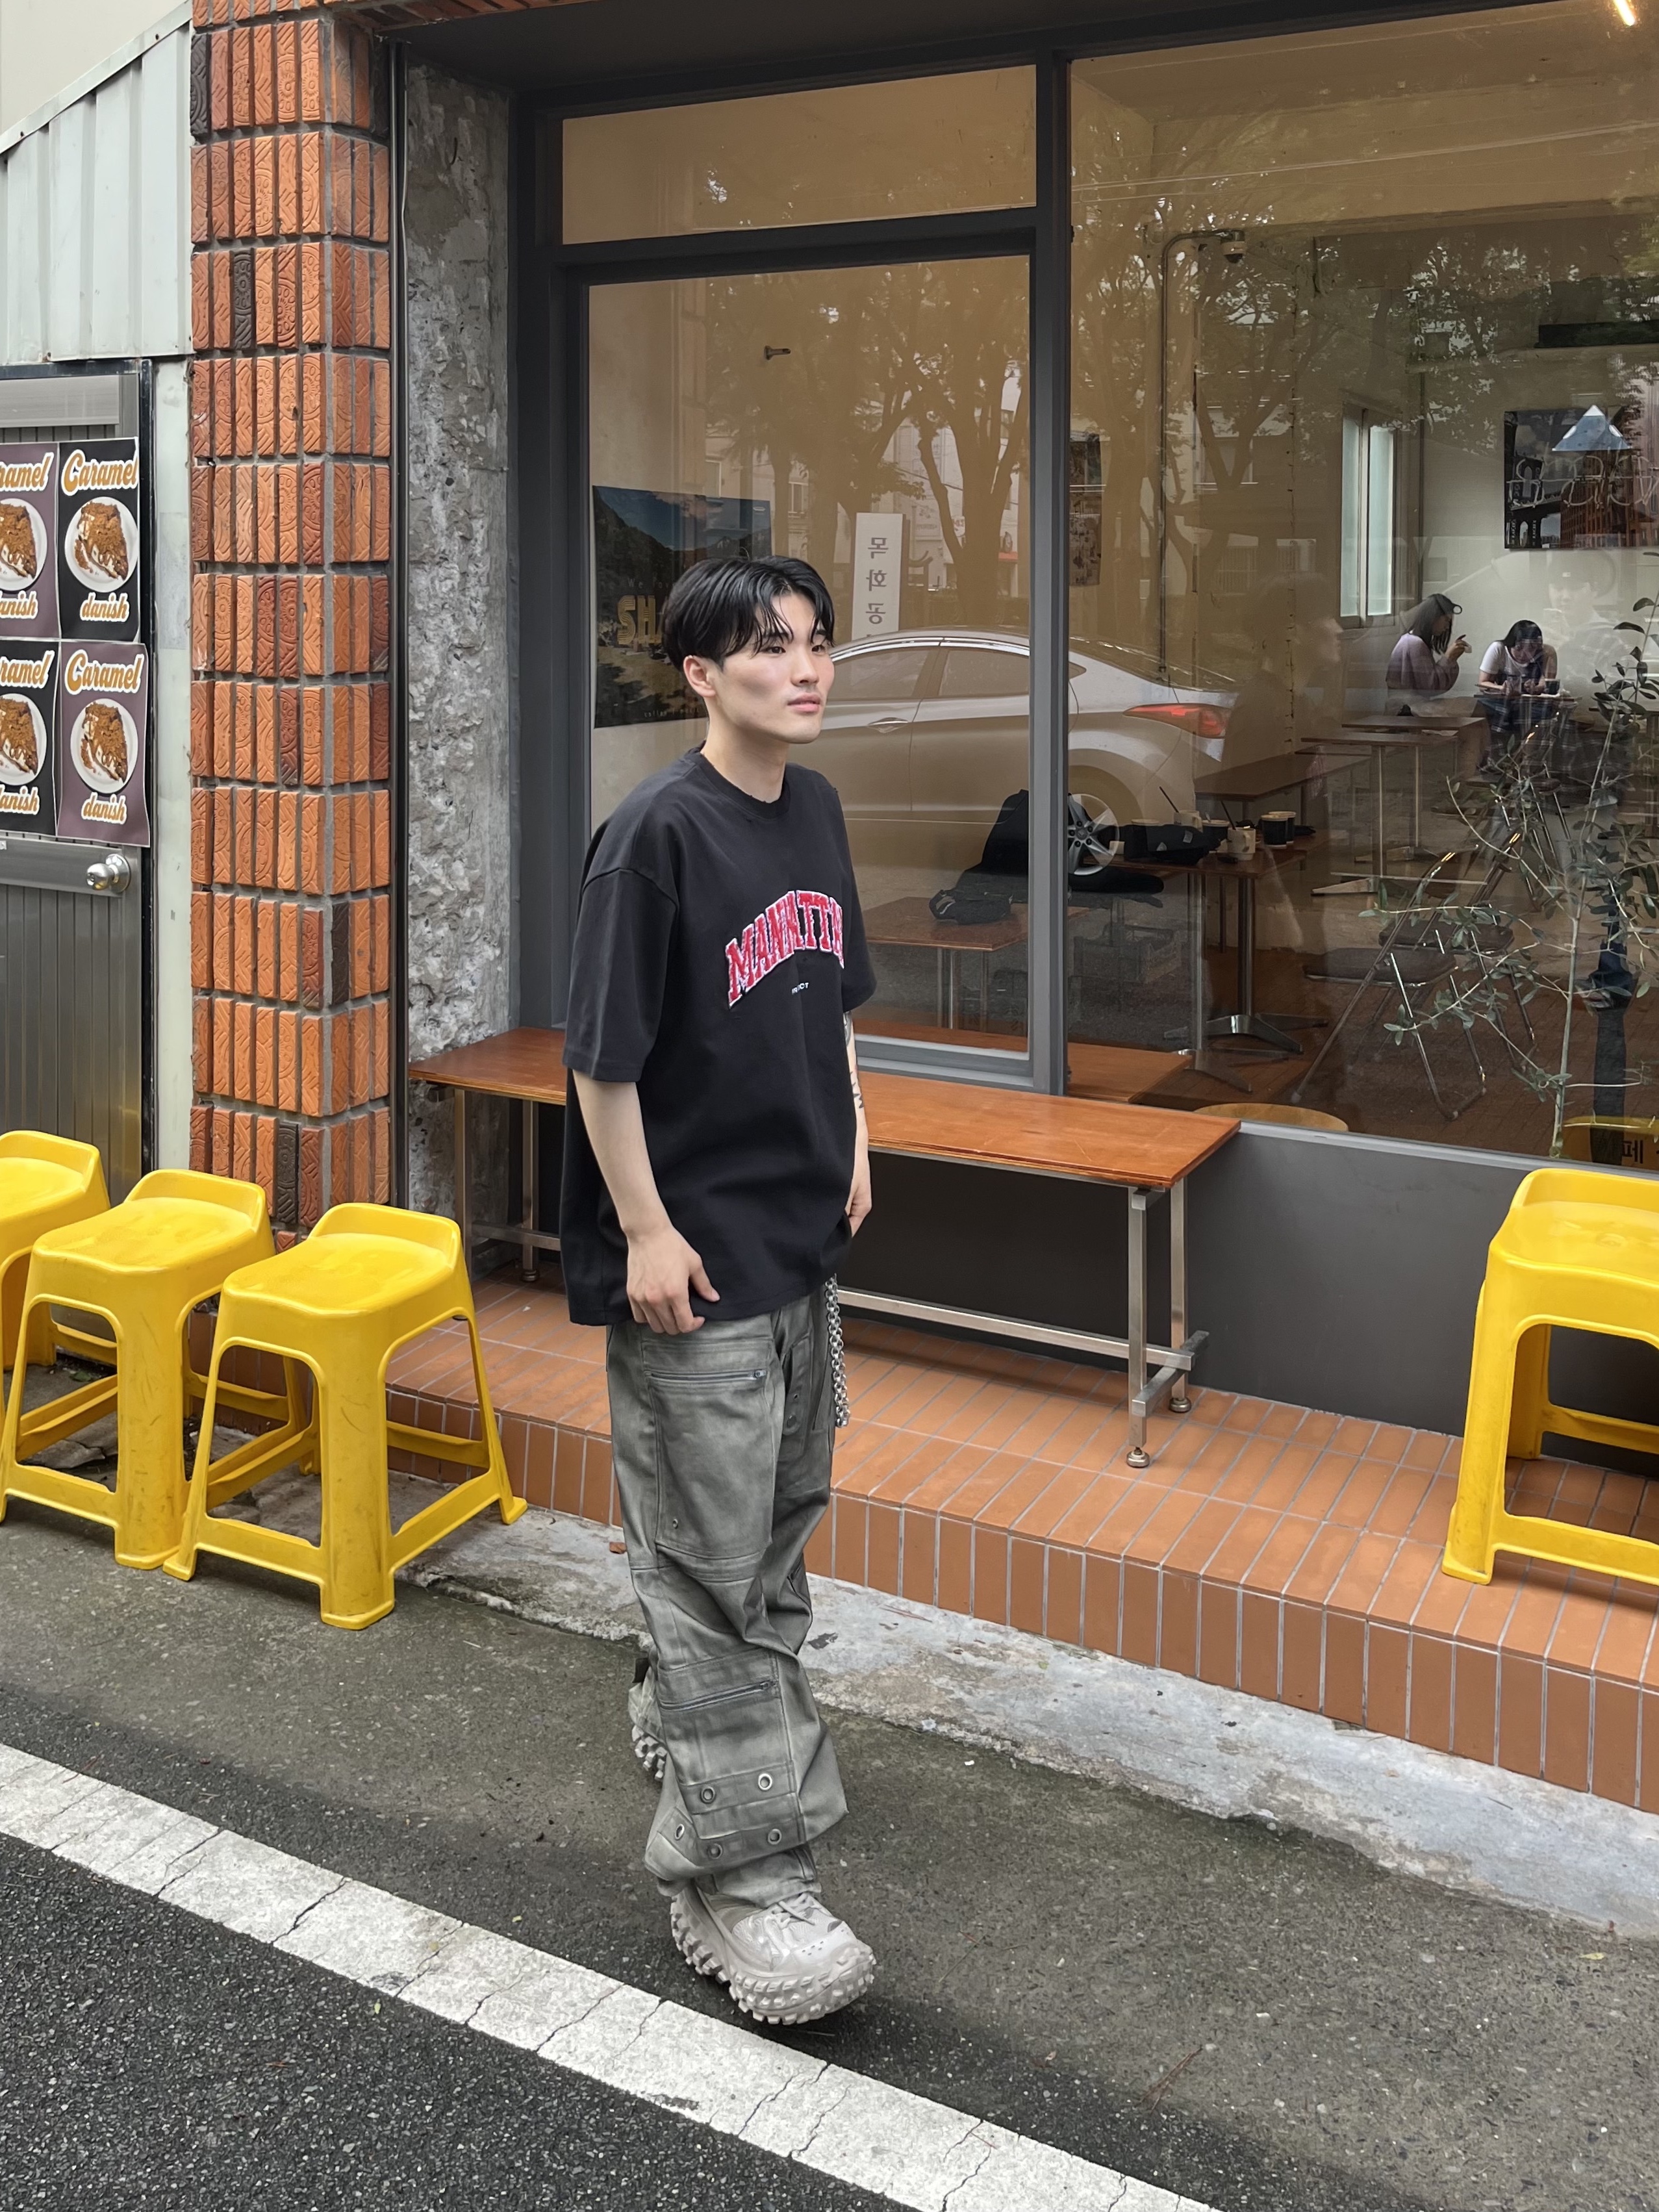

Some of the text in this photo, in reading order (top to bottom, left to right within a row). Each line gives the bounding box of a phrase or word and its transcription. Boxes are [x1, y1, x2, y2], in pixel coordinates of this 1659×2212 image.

[0, 454, 53, 490] ramel
[62, 451, 138, 494] Caramel
[0, 592, 38, 618] anish
[81, 593, 129, 620] danish
[0, 652, 53, 687] ramel
[66, 651, 143, 693] Caramel
[82, 793, 126, 822] danish
